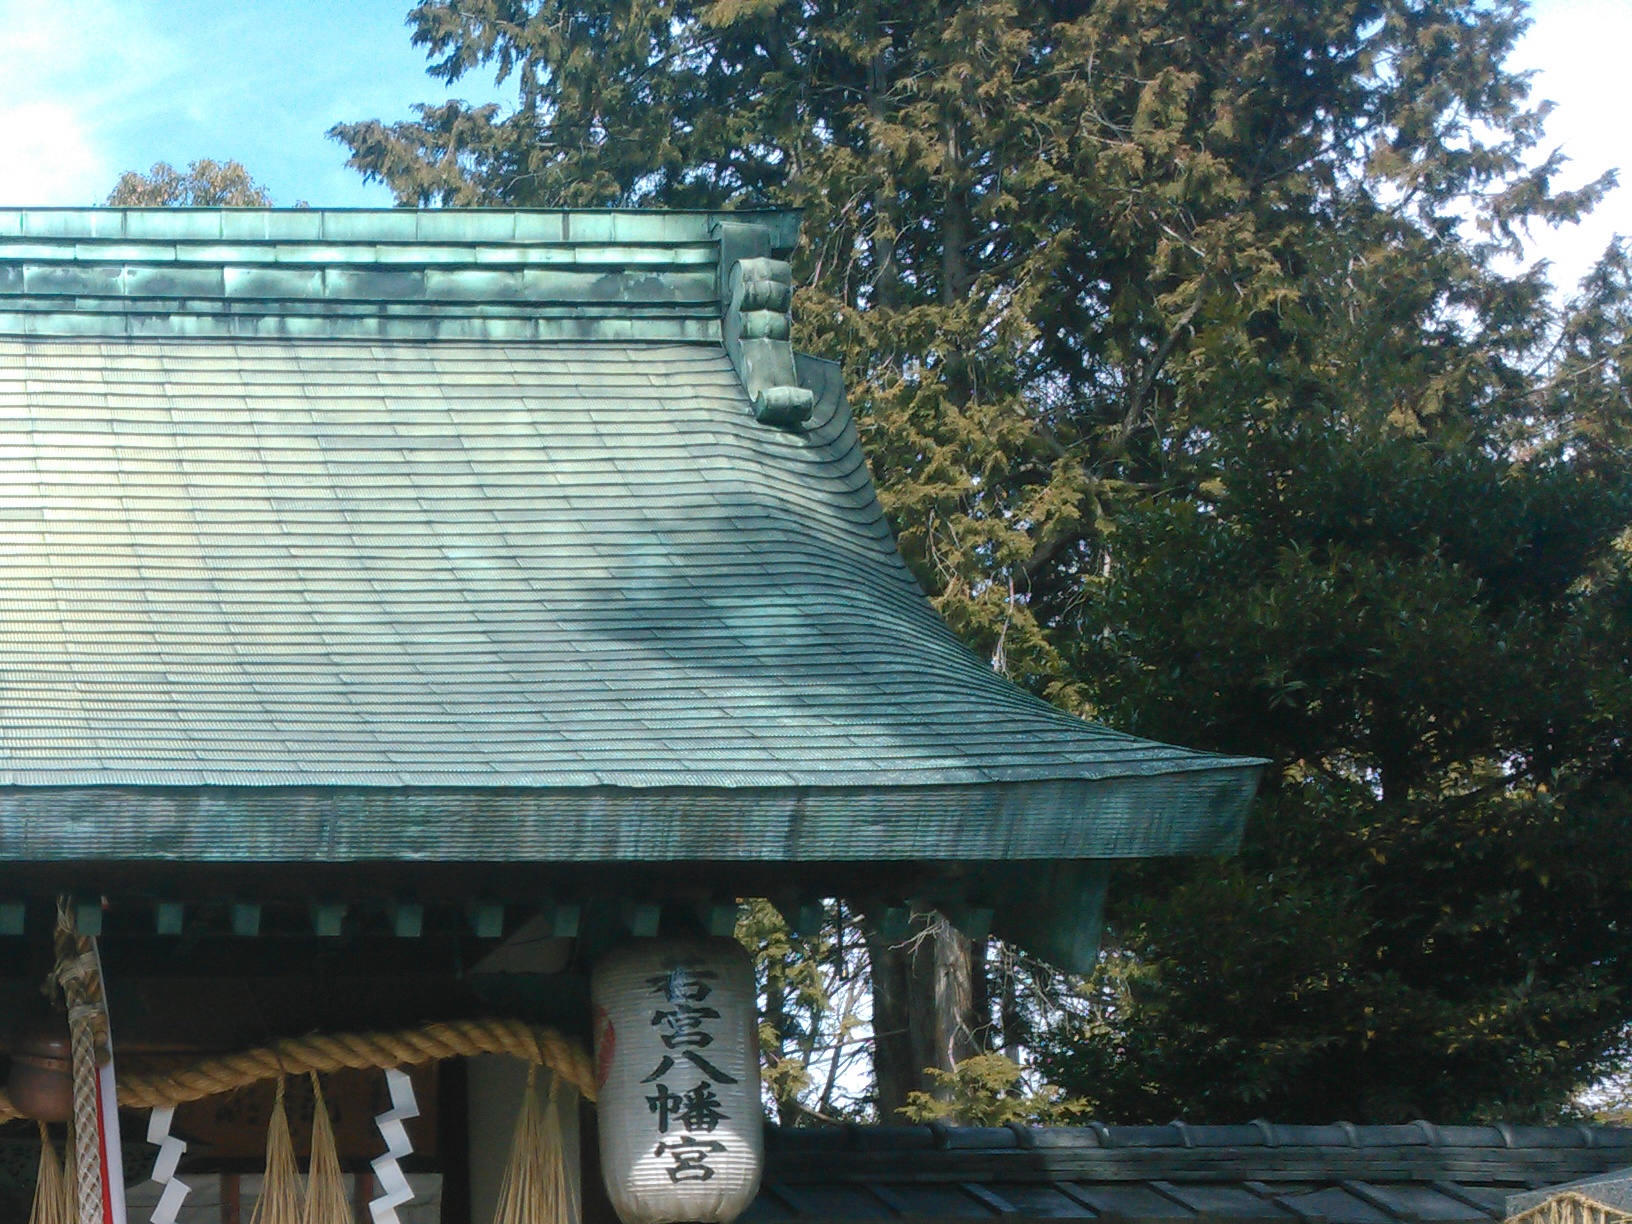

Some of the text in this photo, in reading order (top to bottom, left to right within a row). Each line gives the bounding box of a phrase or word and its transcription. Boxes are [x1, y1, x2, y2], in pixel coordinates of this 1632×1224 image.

[640, 957, 738, 1184] 若宮八幡宮
